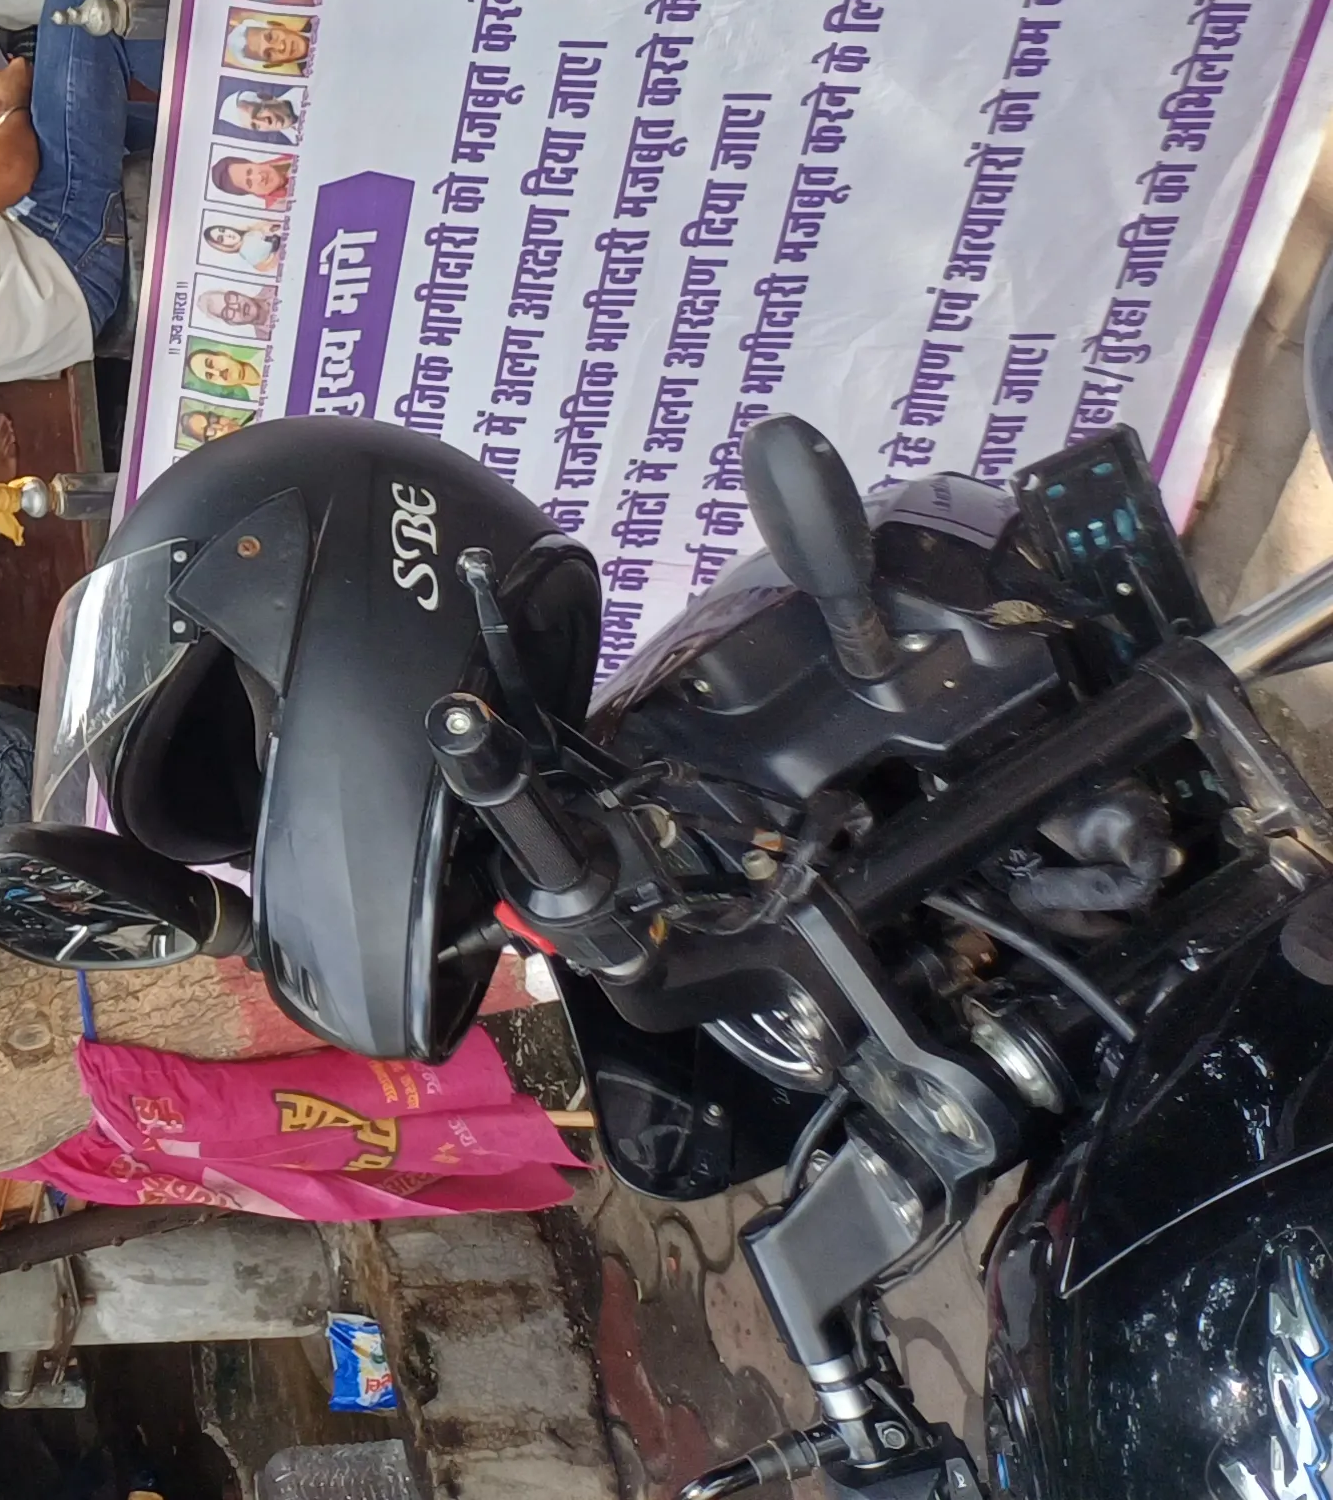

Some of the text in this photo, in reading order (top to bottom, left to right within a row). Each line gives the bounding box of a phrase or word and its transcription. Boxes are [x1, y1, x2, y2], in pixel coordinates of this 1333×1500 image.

[547, 39, 609, 119] जाए।
[636, 33, 695, 107] करने
[810, 41, 871, 75] के
[1001, 16, 1062, 81] कम
[450, 62, 525, 163] मजबूत
[801, 82, 861, 155] करने
[978, 88, 1040, 135] को
[431, 172, 489, 214] को
[519, 128, 587, 196] दिया
[611, 116, 689, 219] मजबूत
[1134, 160, 1197, 205] को
[770, 163, 851, 264] मजबूत
[941, 141, 1026, 282] अत्याचारों
[1114, 211, 1181, 290] जाति
[317, 229, 379, 318] मांगे
[413, 223, 480, 347] भागीदारी
[507, 204, 570, 321] आरक्षण
[582, 227, 651, 352] भागीदारी
[169, 291, 189, 344] जय भारत
[601, 91, 773, 591] की सीटों में अलग आरक्षण दिया जाए।
[731, 273, 810, 394] भागीदारी
[925, 287, 980, 333] एवं
[489, 326, 546, 406] अलग
[890, 340, 964, 427] शोषण
[472, 410, 527, 437] में
[554, 359, 619, 491] राजनैतिक
[969, 331, 1057, 487] नाया जाए।
[877, 432, 936, 468] रहे
[389, 481, 440, 611] SBE
[540, 497, 590, 535] की
[695, 498, 749, 537] की
[684, 543, 738, 586] वर्ग
